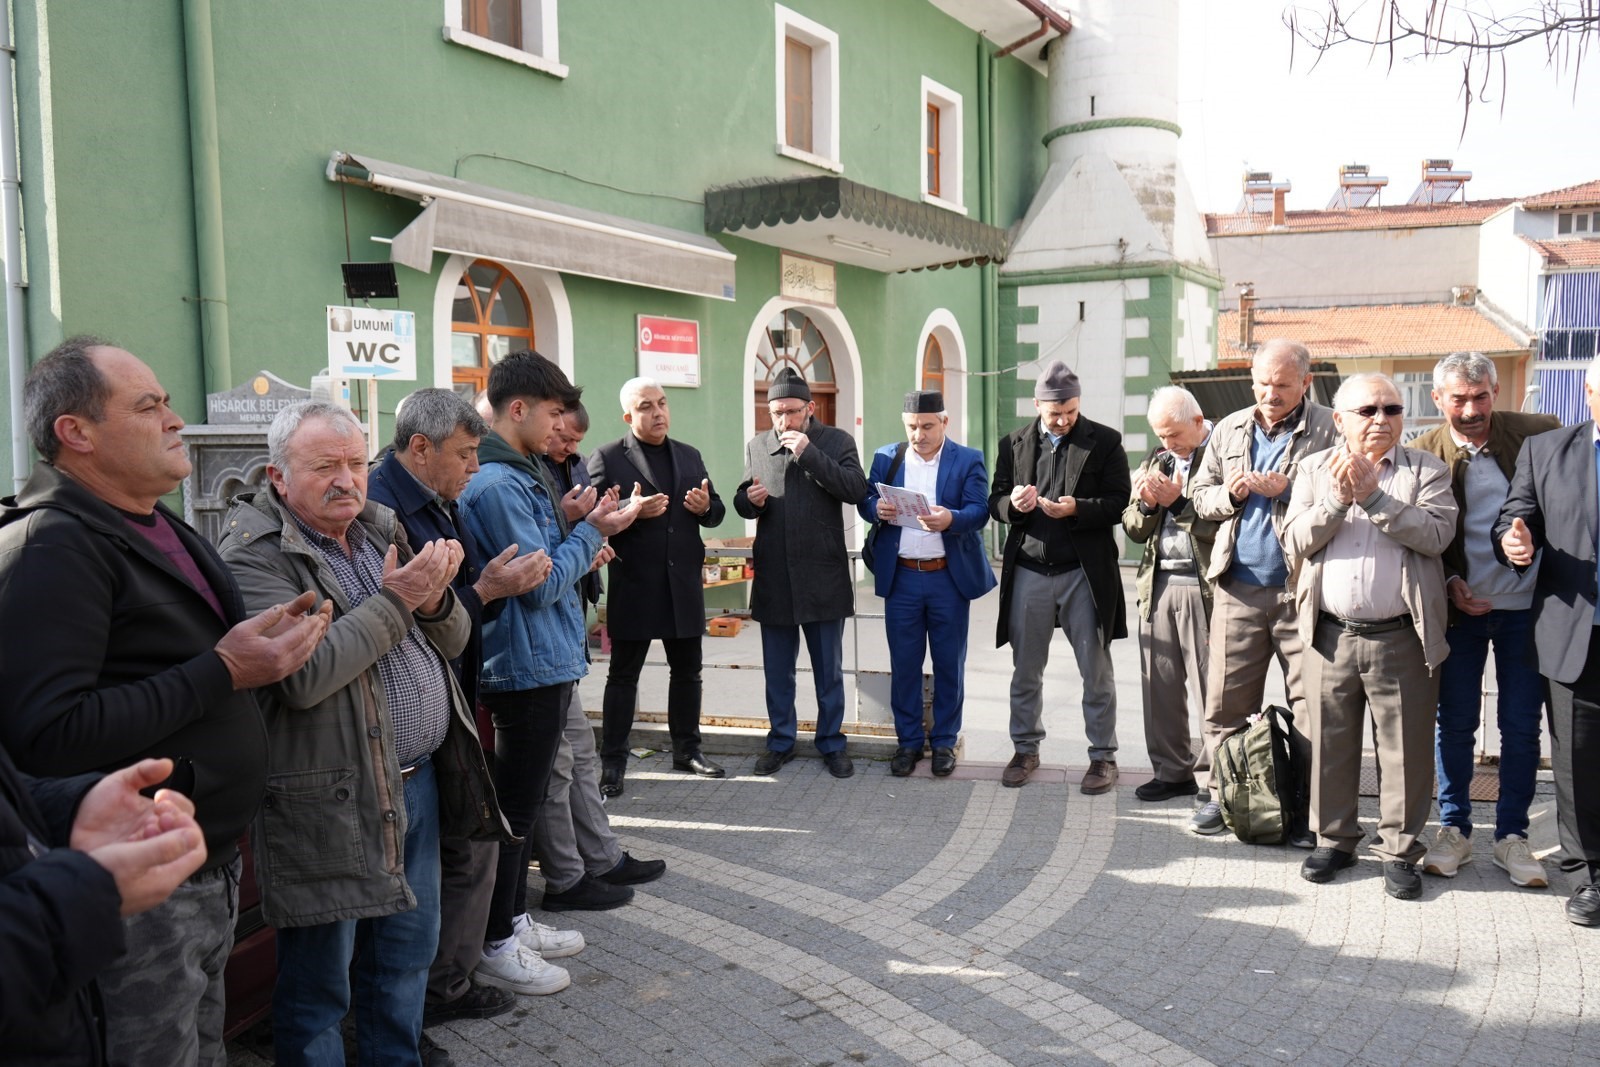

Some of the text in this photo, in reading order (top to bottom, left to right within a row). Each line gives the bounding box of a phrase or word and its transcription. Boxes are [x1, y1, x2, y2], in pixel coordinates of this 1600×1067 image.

[353, 318, 393, 332] UMUMİ
[346, 341, 400, 364] WC
[210, 396, 256, 413] HİSARCIK
[240, 413, 267, 423] MEMBA
